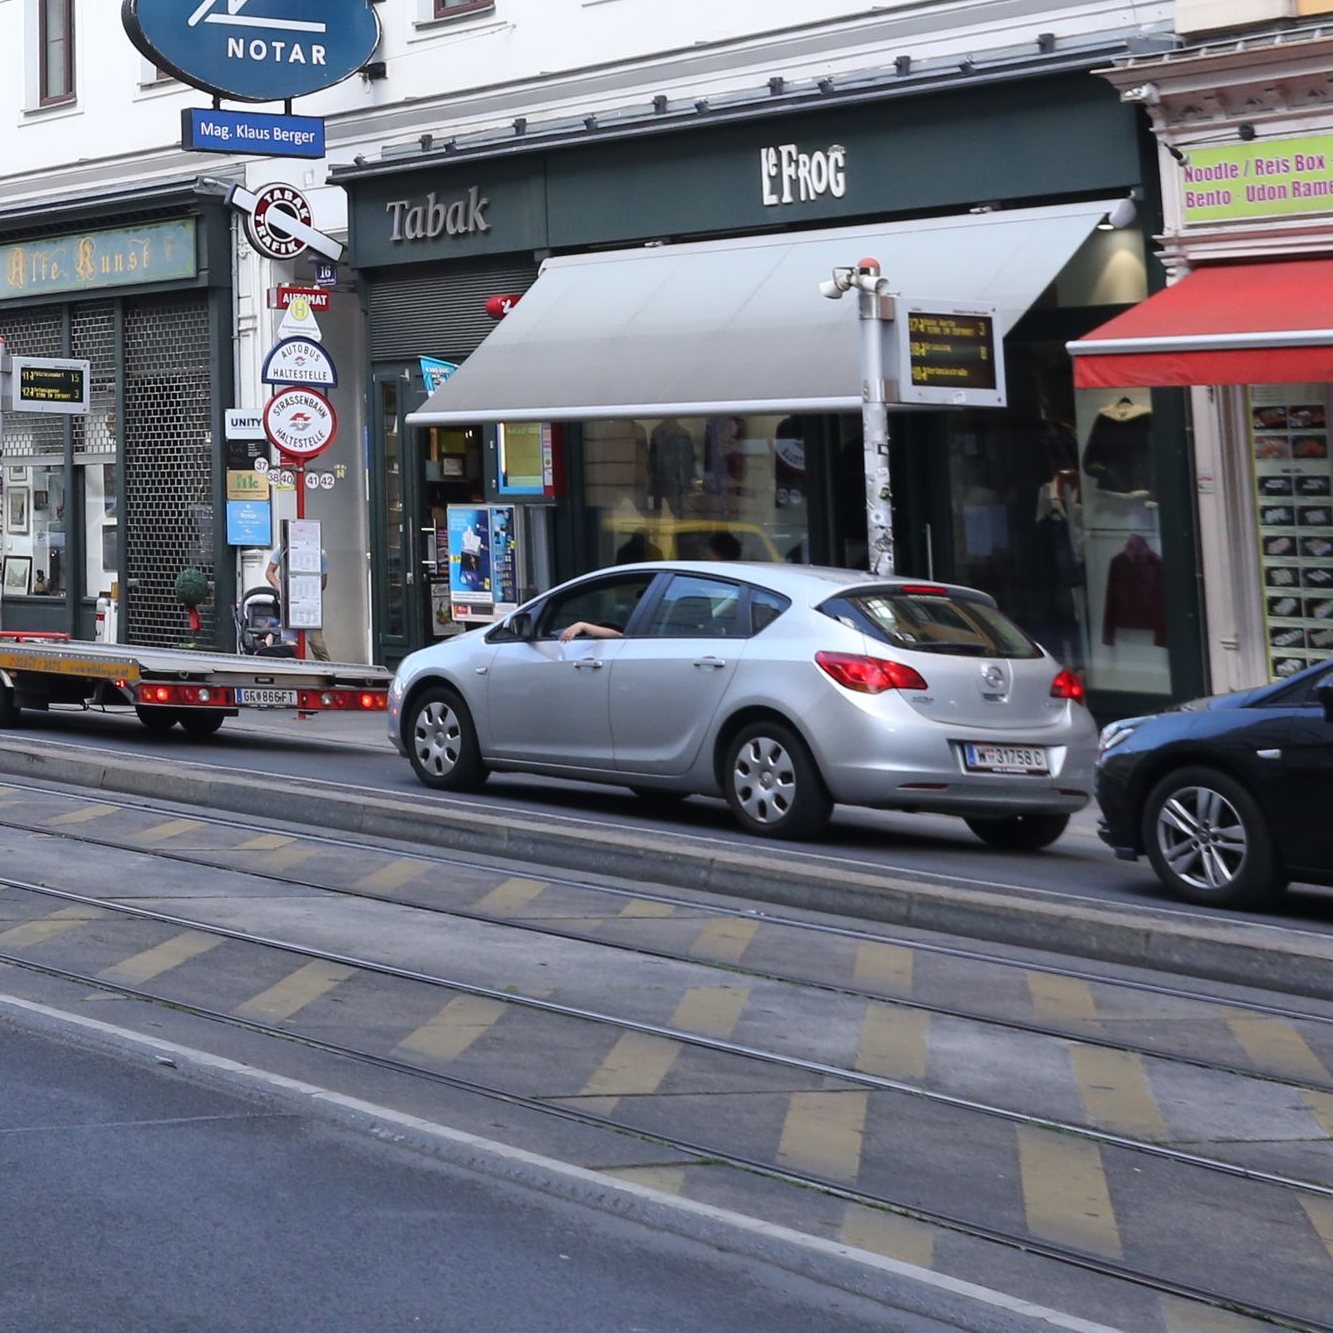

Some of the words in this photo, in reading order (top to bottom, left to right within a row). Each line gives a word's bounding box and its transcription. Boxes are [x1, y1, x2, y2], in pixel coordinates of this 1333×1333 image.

[227, 37, 326, 66] NOTAR
[200, 121, 233, 141] Mag.
[236, 124, 270, 140] Klaus
[273, 127, 316, 145] Berger
[777, 143, 846, 204] FROG
[1184, 162, 1239, 182] Noodle
[1254, 157, 1290, 176] Reis
[1294, 154, 1325, 172] Box
[263, 189, 310, 219] TABAK
[1185, 189, 1232, 208] Bento
[1245, 183, 1288, 203] Udon
[386, 186, 492, 241] Tabak
[255, 213, 298, 254] TRAFIK
[319, 266, 331, 279] 16
[281, 345, 321, 363] AUTOBUS
[71, 373, 80, 383] 15
[273, 367, 328, 382] HALTESTELLE
[272, 395, 328, 420] STRASSENBAHN
[230, 417, 264, 427] UNITY
[275, 427, 326, 449] HALTESTELLE
[255, 461, 267, 470] 37
[267, 473, 279, 483] 38
[280, 475, 293, 485] 40
[307, 476, 318, 485] 41
[321, 476, 333, 486] 42
[262, 691, 280, 702] 866
[996, 749, 1032, 766] 31758
